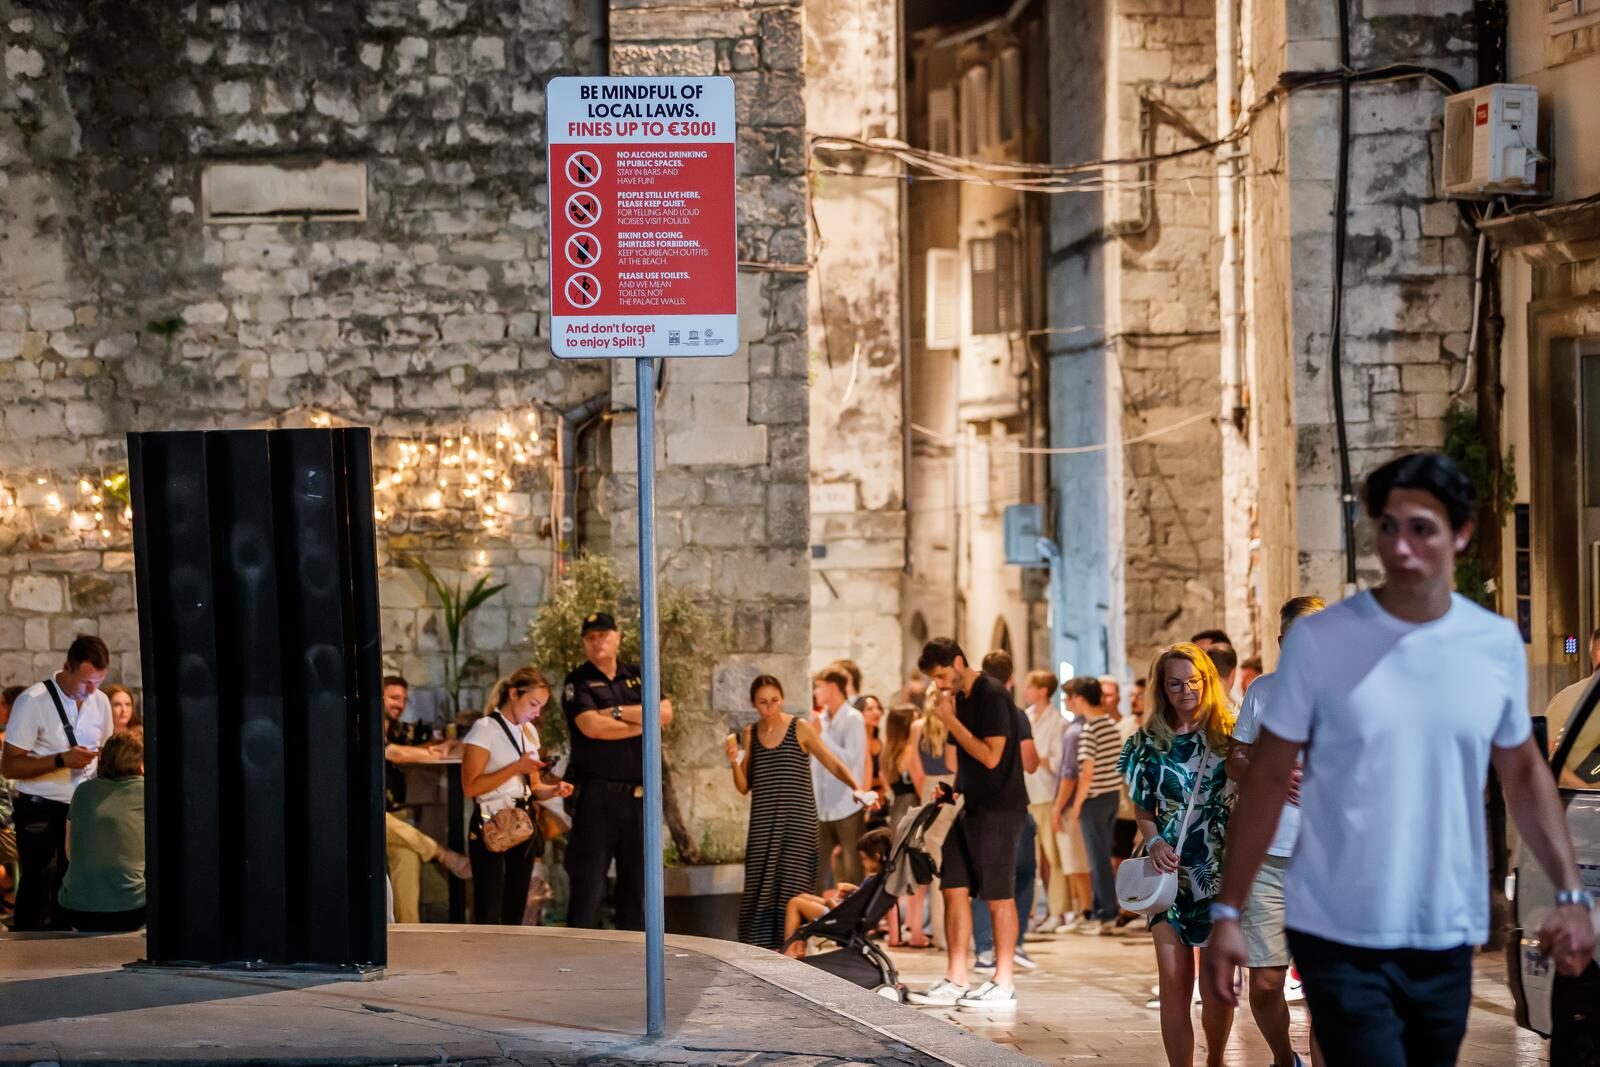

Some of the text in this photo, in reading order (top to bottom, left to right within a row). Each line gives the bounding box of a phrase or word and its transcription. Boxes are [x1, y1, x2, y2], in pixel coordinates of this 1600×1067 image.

[580, 85, 703, 99] BE MINDFUL OF
[588, 104, 699, 118] LOCAL LAWS.
[568, 122, 716, 136] FINES UP TO €300!
[566, 323, 655, 335] And don't forget
[567, 337, 578, 346] to
[580, 337, 610, 348] enjoy
[612, 336, 637, 348] Split
